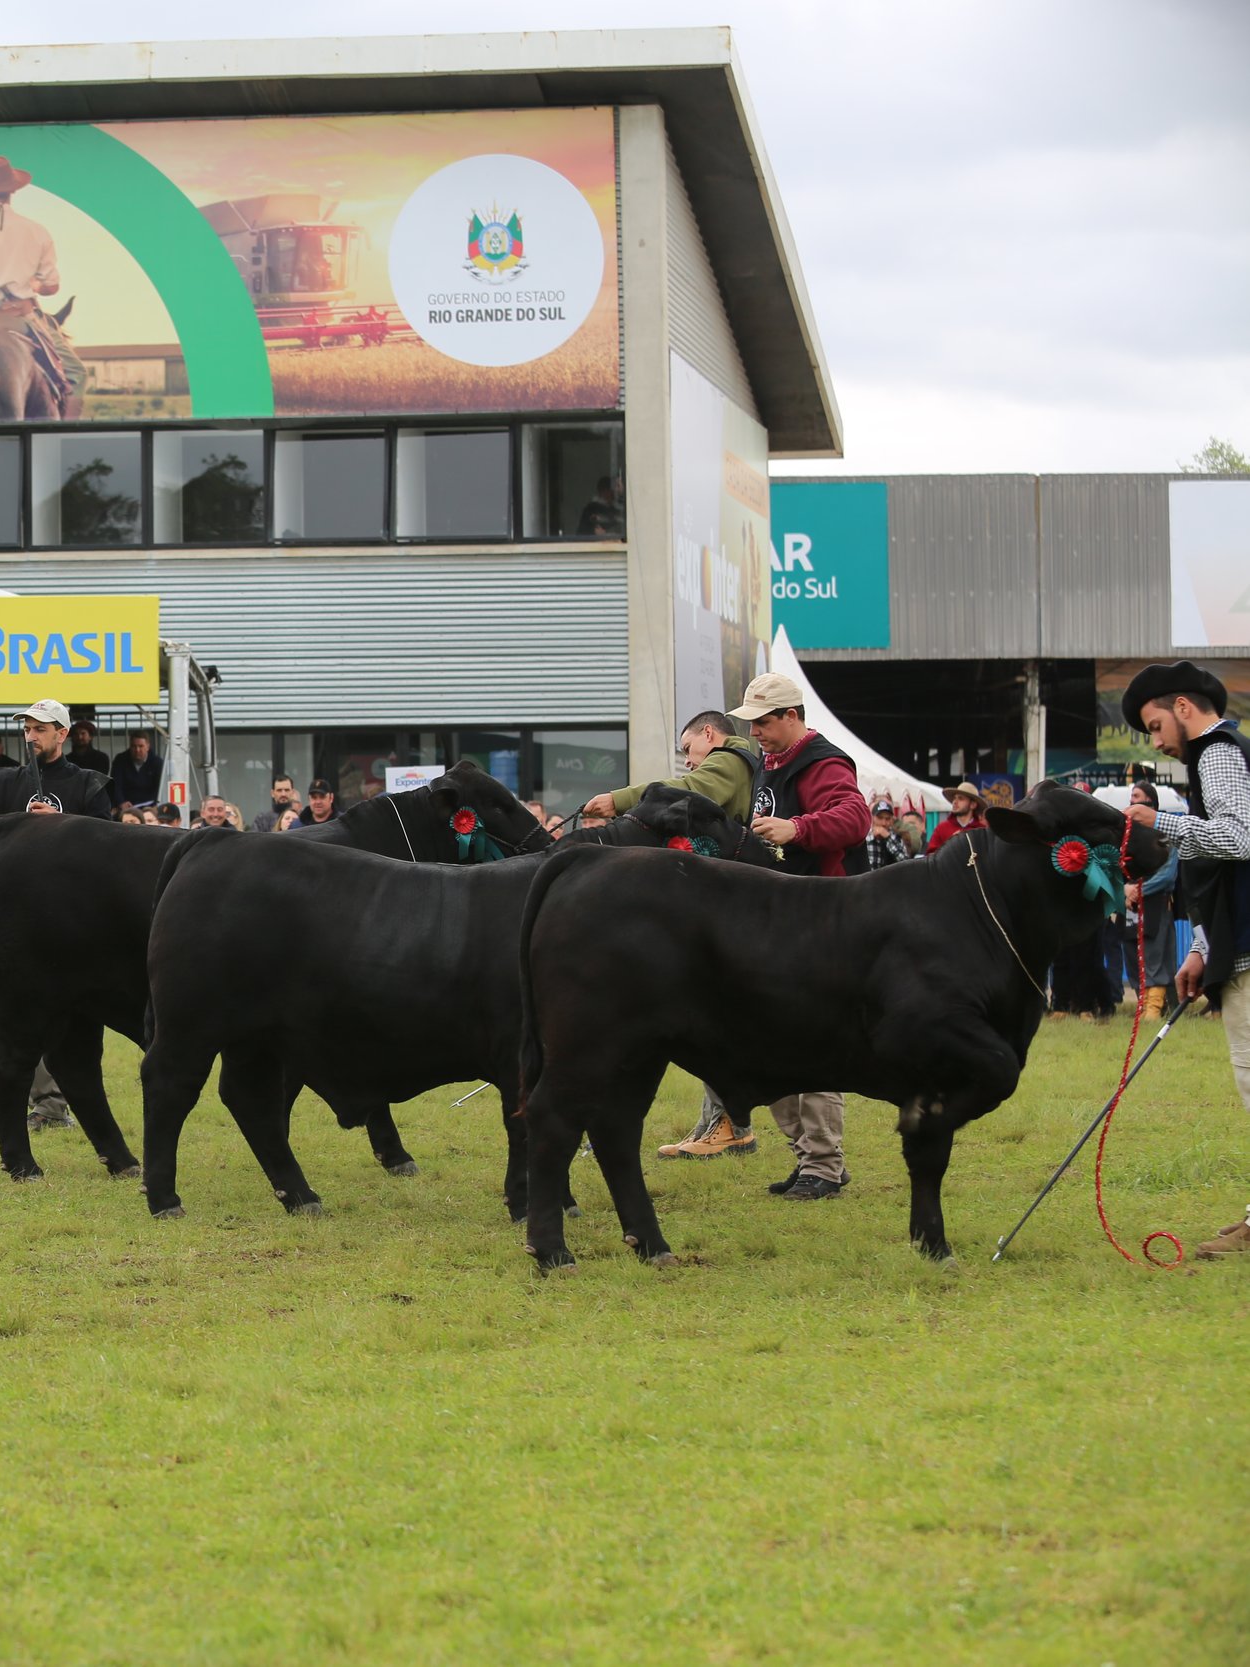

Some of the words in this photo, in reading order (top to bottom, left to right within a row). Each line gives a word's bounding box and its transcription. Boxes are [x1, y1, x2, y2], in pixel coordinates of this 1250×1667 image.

[427, 292, 490, 305] GOVERNO
[494, 291, 511, 303] DO
[516, 290, 565, 303] ESTADO
[429, 310, 452, 324] RIO
[455, 308, 512, 323] GRANDE
[516, 307, 535, 321] DO
[539, 306, 566, 320] SUL
[772, 576, 801, 599] do
[804, 576, 838, 599] Sul
